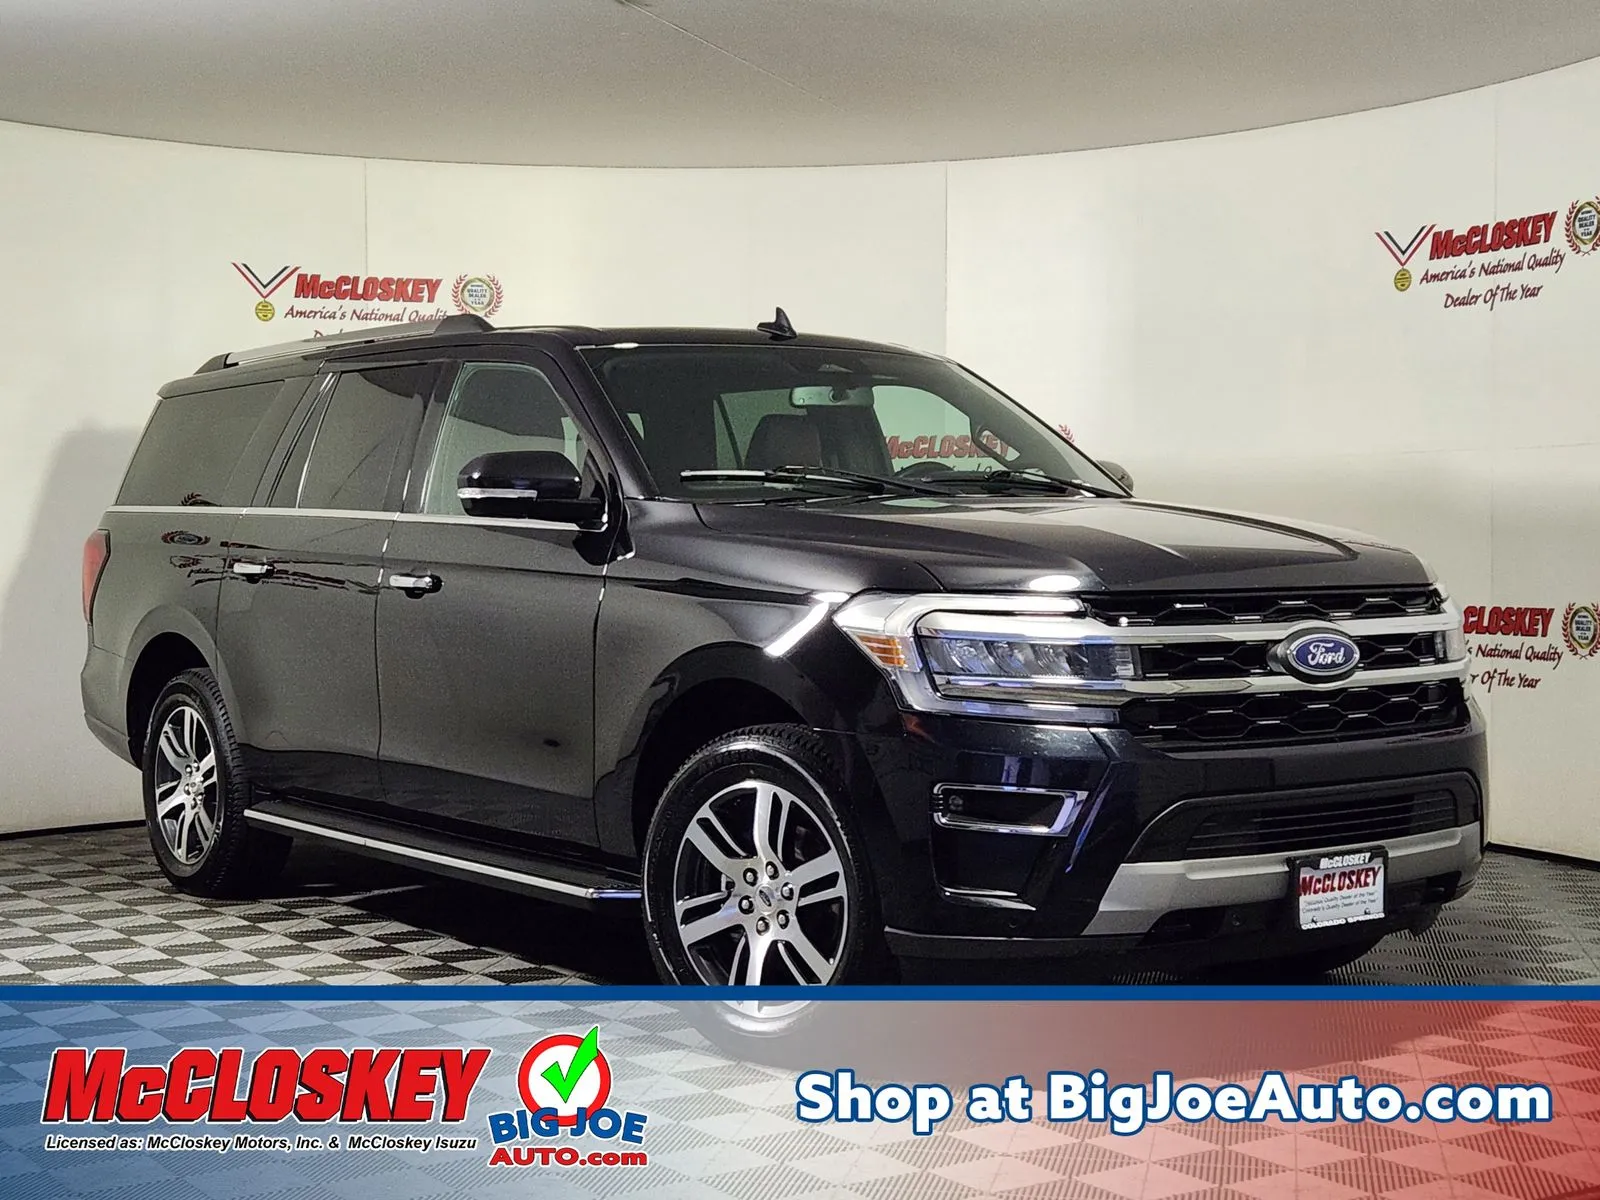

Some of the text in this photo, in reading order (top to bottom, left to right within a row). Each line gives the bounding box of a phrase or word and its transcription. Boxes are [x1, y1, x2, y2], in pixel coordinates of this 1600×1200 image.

[1429, 211, 1558, 260] McCLOSKEY
[1419, 260, 1475, 285] America's
[1478, 252, 1524, 277] National
[1527, 247, 1566, 274] Quality
[294, 273, 443, 303] McCLOSKEY
[1443, 282, 1543, 311] Dealer Of The Year
[284, 305, 346, 320] America's
[350, 307, 405, 322] National
[408, 308, 449, 323] Qualit
[1463, 605, 1555, 637] CLOSKEY
[1307, 642, 1346, 665] Ford
[1476, 641, 1522, 660] National
[1525, 644, 1563, 670] Quality
[1481, 668, 1497, 693] Of
[1498, 669, 1515, 686] The
[1518, 672, 1542, 689] Year
[1319, 852, 1371, 869] McCLOSKEY
[1297, 866, 1382, 897] McCLOSKEY
